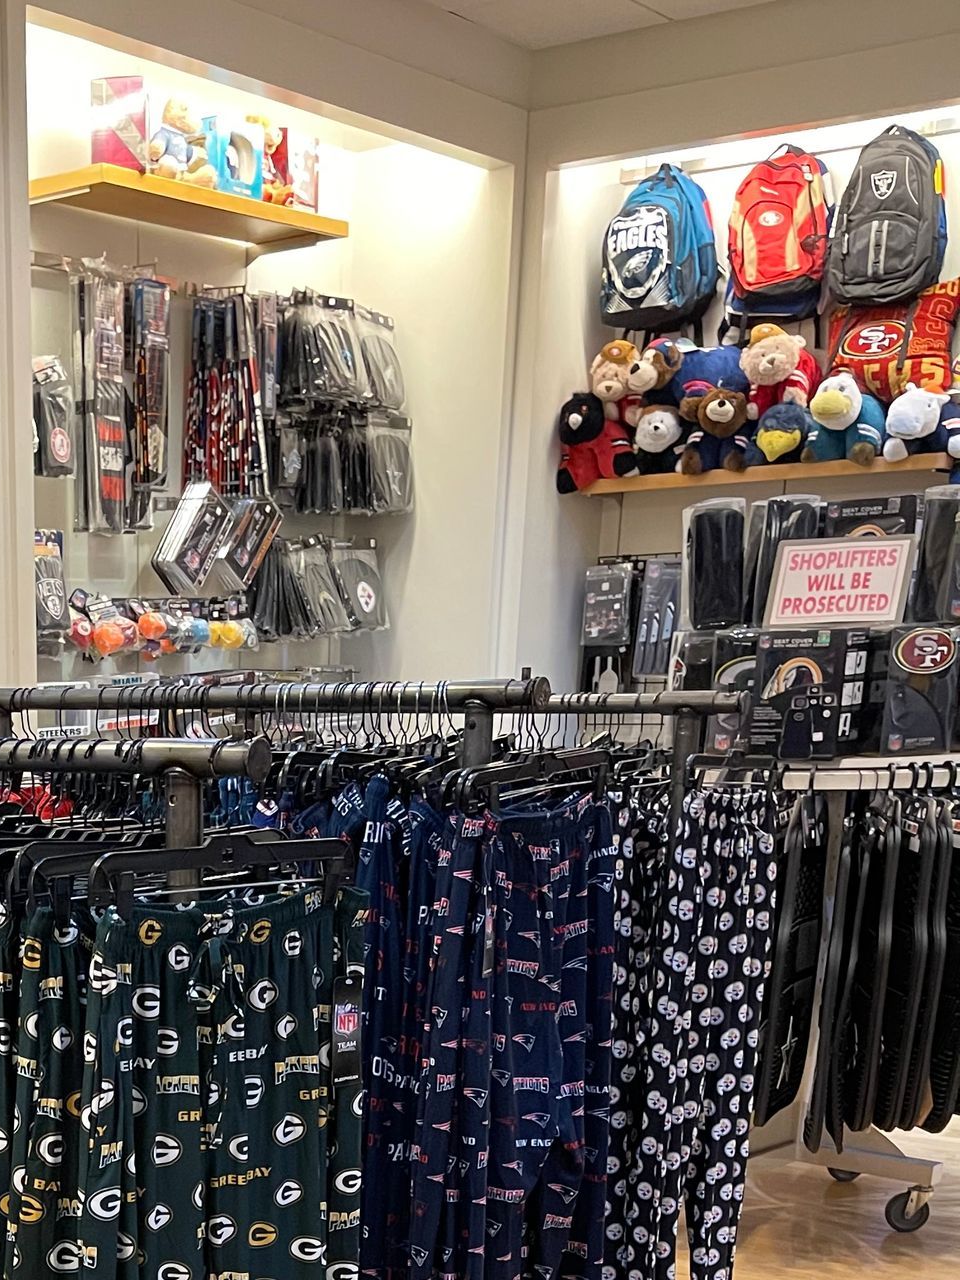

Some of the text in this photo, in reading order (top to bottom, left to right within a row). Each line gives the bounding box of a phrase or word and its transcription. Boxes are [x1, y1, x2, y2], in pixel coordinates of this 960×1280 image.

[608, 225, 667, 259] EAGLES
[790, 549, 897, 571] SHOPLIFTERS
[808, 572, 872, 592] WILL BE
[781, 594, 889, 615] PROSECUTED
[112, 677, 142, 686] MIAMI
[339, 1013, 358, 1031] NFL
[338, 1041, 357, 1049] TEAM
[211, 1174, 247, 1187] GREE
